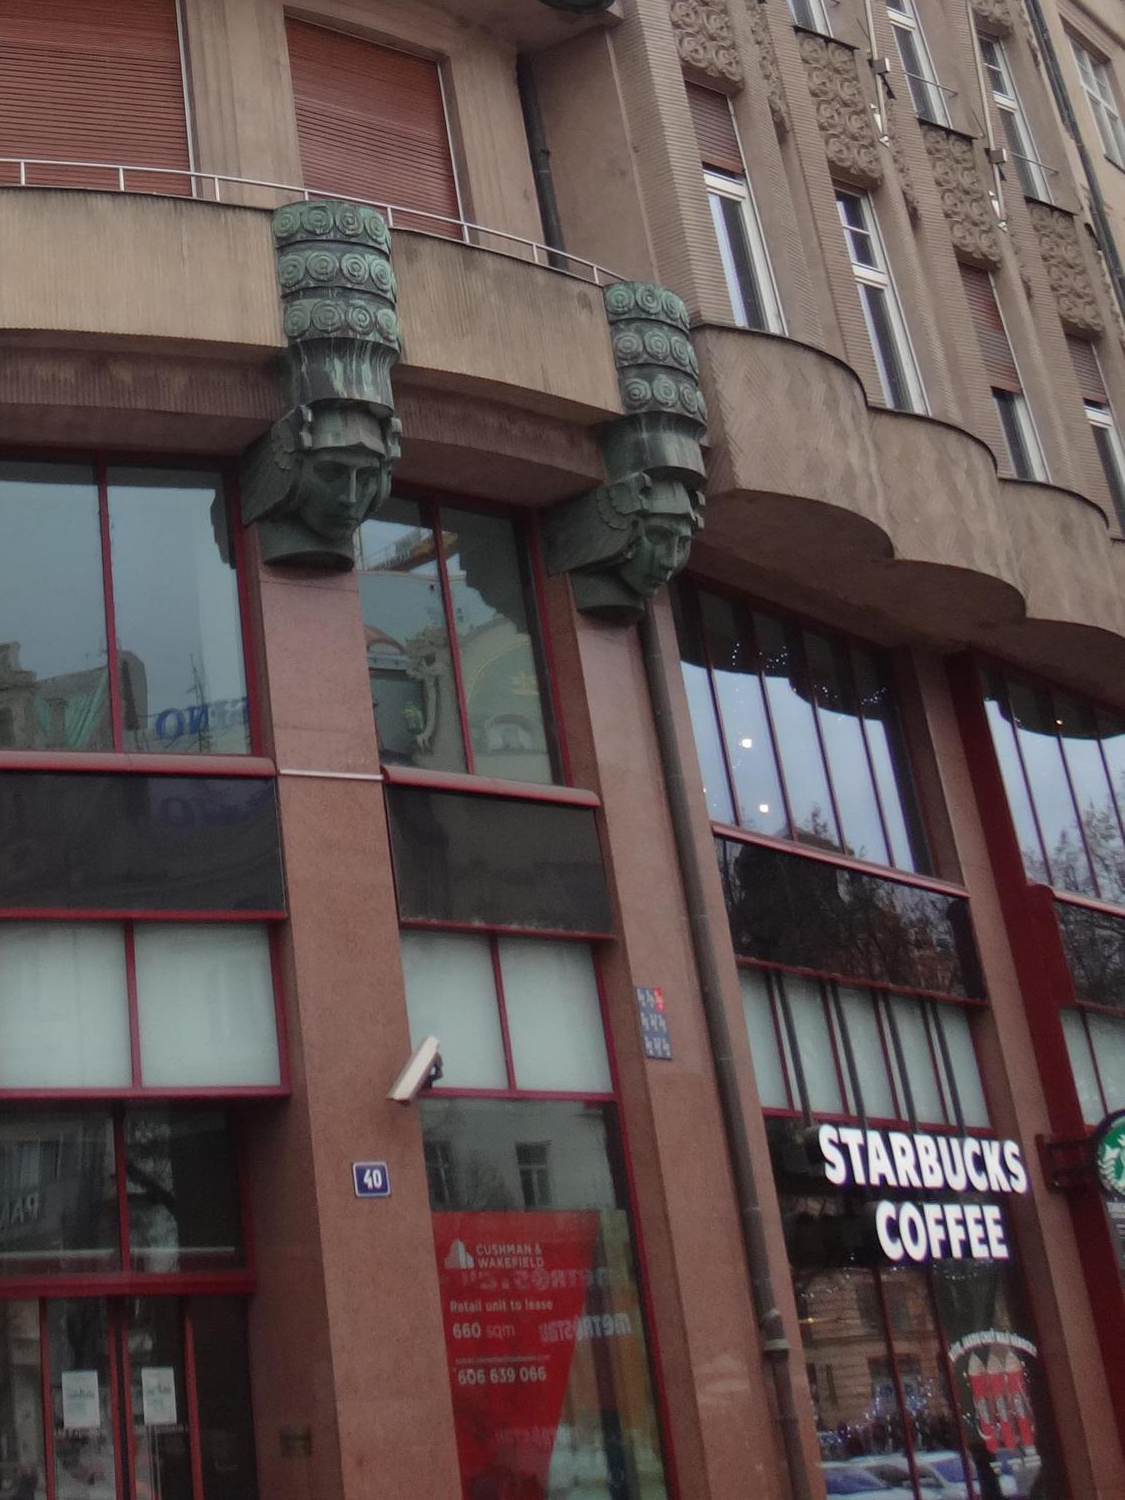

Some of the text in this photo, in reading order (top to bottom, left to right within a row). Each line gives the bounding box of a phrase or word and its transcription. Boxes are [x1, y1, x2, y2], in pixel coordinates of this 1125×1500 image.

[818, 1123, 1028, 1194] STARBUCKS
[363, 1167, 383, 1189] 40
[875, 1200, 1009, 1262] COFFEE
[476, 1243, 543, 1255] CUSHMAN &
[477, 1256, 544, 1269] WAKEFIELD
[450, 1299, 553, 1313] Retail unit to lease
[452, 1322, 515, 1340] 660 sqm
[489, 1366, 515, 1383] 639
[520, 1365, 547, 1382] 066
